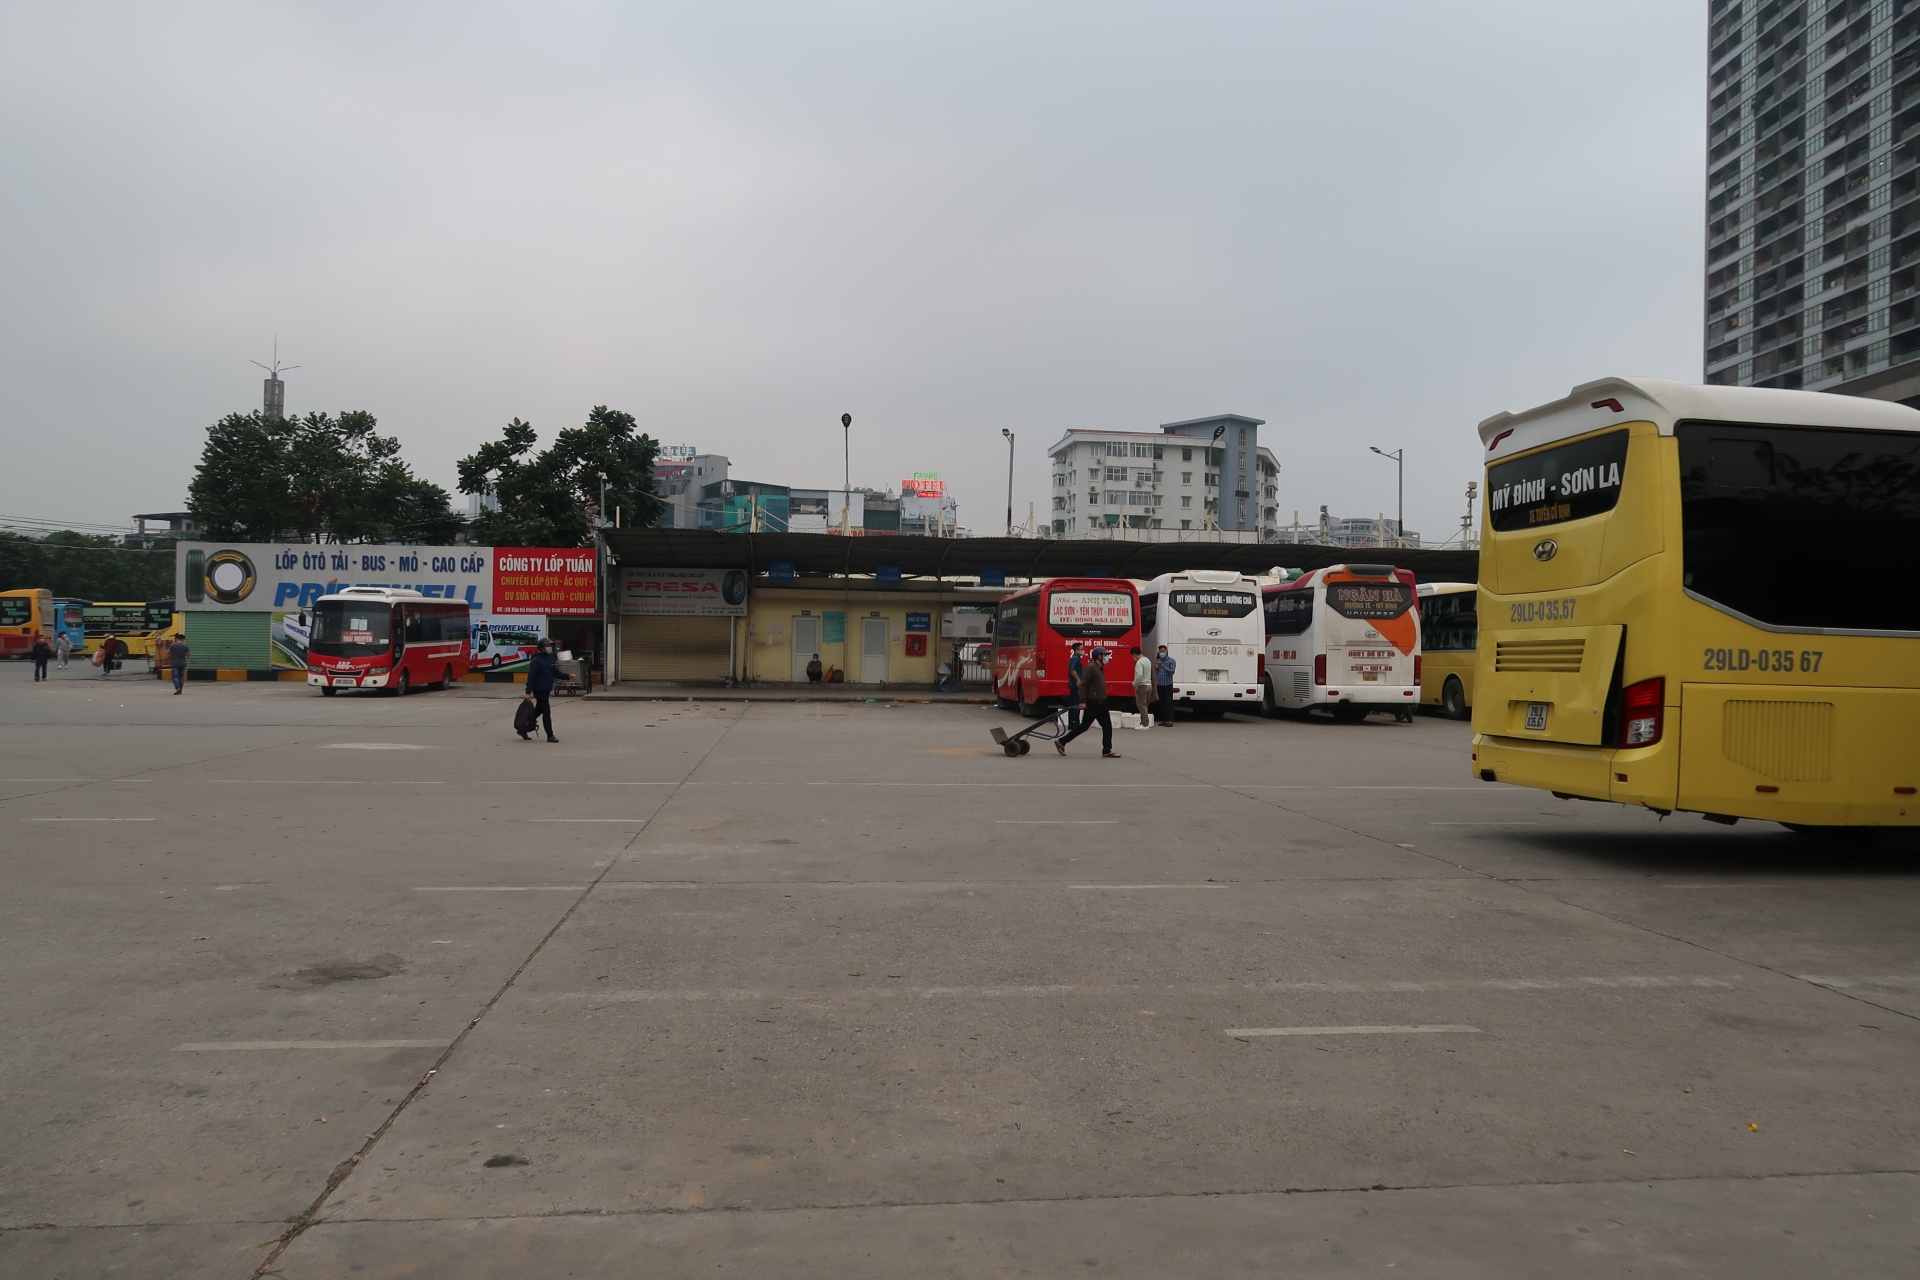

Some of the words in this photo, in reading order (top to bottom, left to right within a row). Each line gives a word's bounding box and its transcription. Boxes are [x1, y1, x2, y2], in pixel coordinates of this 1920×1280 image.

[1493, 483, 1511, 511] MỸ
[1513, 478, 1546, 506] ĐÌNH
[1561, 467, 1594, 496] SƠN
[1599, 462, 1620, 489] LA
[276, 548, 298, 570] LỐP
[303, 551, 326, 570] ÔTÔ
[331, 550, 349, 571] TẢI
[362, 556, 386, 571] BUS
[399, 551, 419, 572] MỎ
[432, 556, 456, 573] CAO
[460, 551, 485, 573] CẤP
[500, 554, 528, 572] CÔNG
[530, 558, 542, 572] TY
[545, 554, 564, 572] LỐP
[566, 554, 593, 573] TUẤN
[501, 574, 529, 586] CHUYÊN
[531, 574, 544, 586] LỐP
[574, 578, 588, 588] QUY
[626, 581, 719, 593] PRESA
[505, 592, 514, 600] DV
[1338, 587, 1380, 602] NGÂN
[1382, 588, 1404, 603] HÀ
[1065, 606, 1075, 616] SƠN
